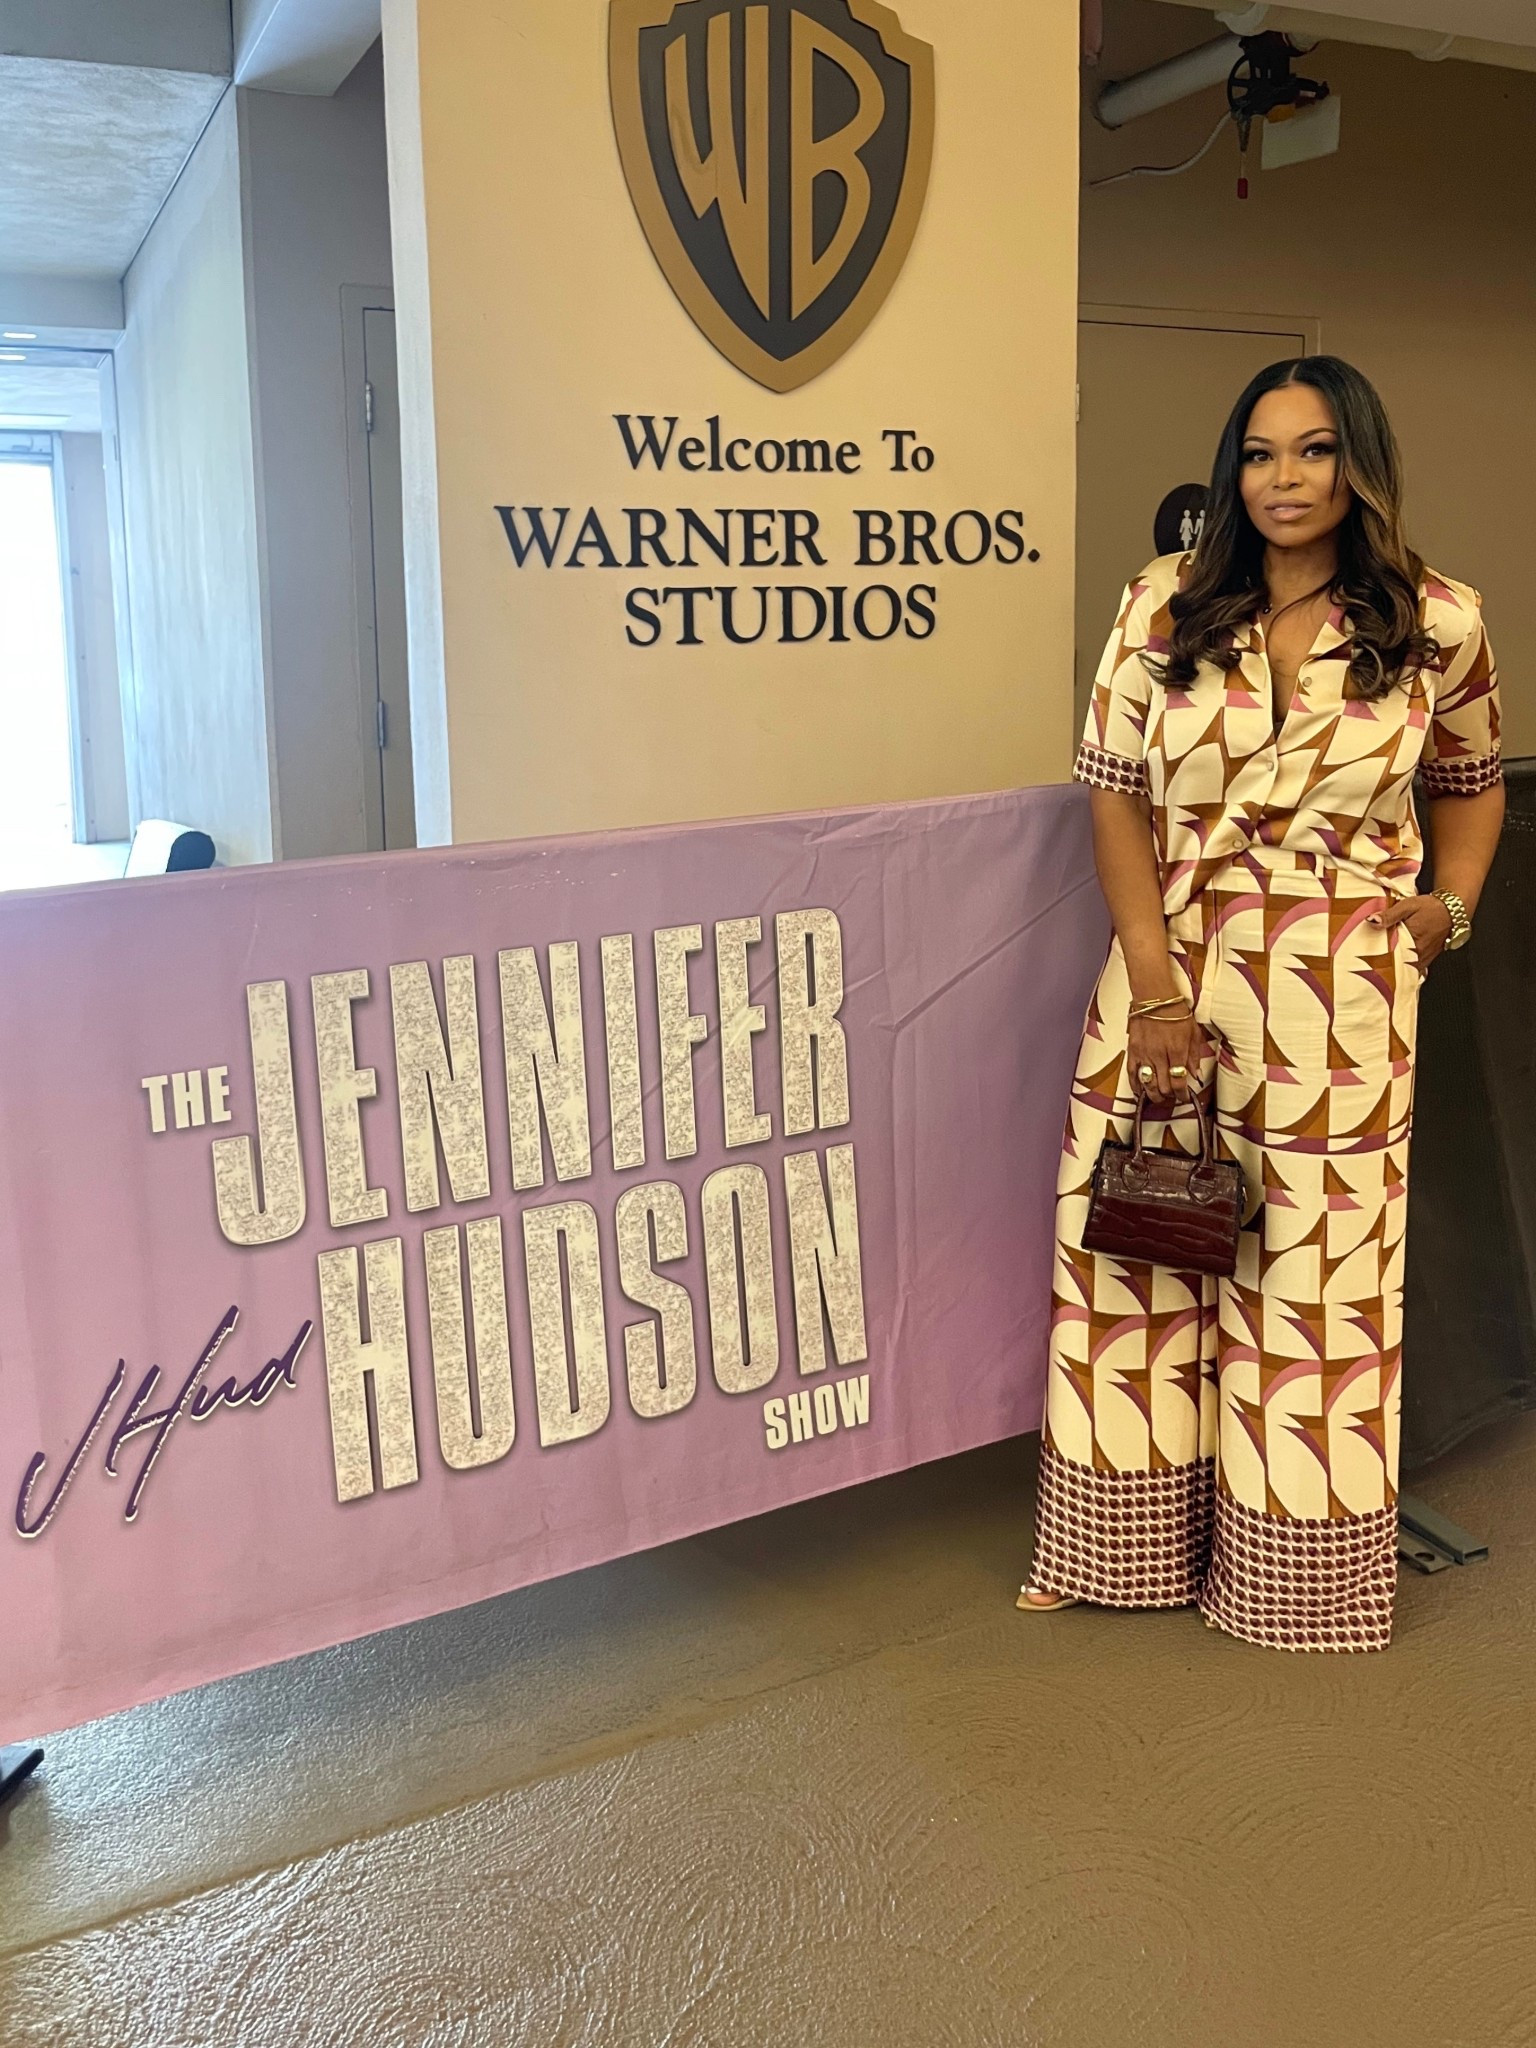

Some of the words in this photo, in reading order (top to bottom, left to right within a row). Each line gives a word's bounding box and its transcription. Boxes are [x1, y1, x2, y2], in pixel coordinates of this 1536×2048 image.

[664, 4, 886, 322] WB
[612, 414, 861, 474] Welcome
[881, 429, 935, 473] To
[494, 505, 828, 568] WARNER
[853, 508, 1041, 566] BROS.
[624, 583, 936, 646] STUDIOS
[142, 1066, 231, 1132] THE
[211, 907, 851, 1246] JENNIFER
[317, 1142, 868, 1503] HUDSON
[763, 1374, 870, 1450] SHOW
